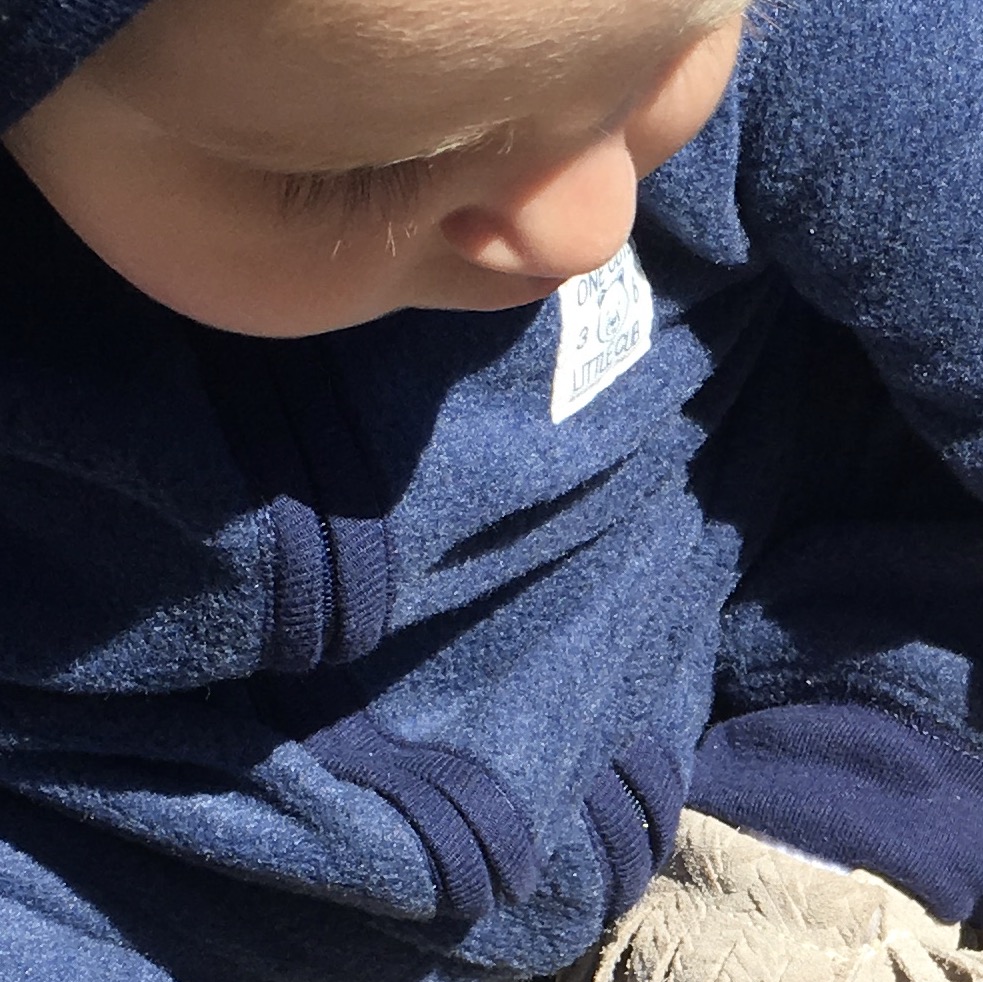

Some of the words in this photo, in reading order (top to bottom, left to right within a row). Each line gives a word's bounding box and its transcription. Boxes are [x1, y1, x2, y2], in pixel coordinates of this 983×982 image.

[576, 326, 589, 350] 3
[631, 276, 640, 303] 6
[577, 268, 605, 306] ONE
[573, 341, 614, 391] LITTLE
[614, 320, 640, 356] CUB
